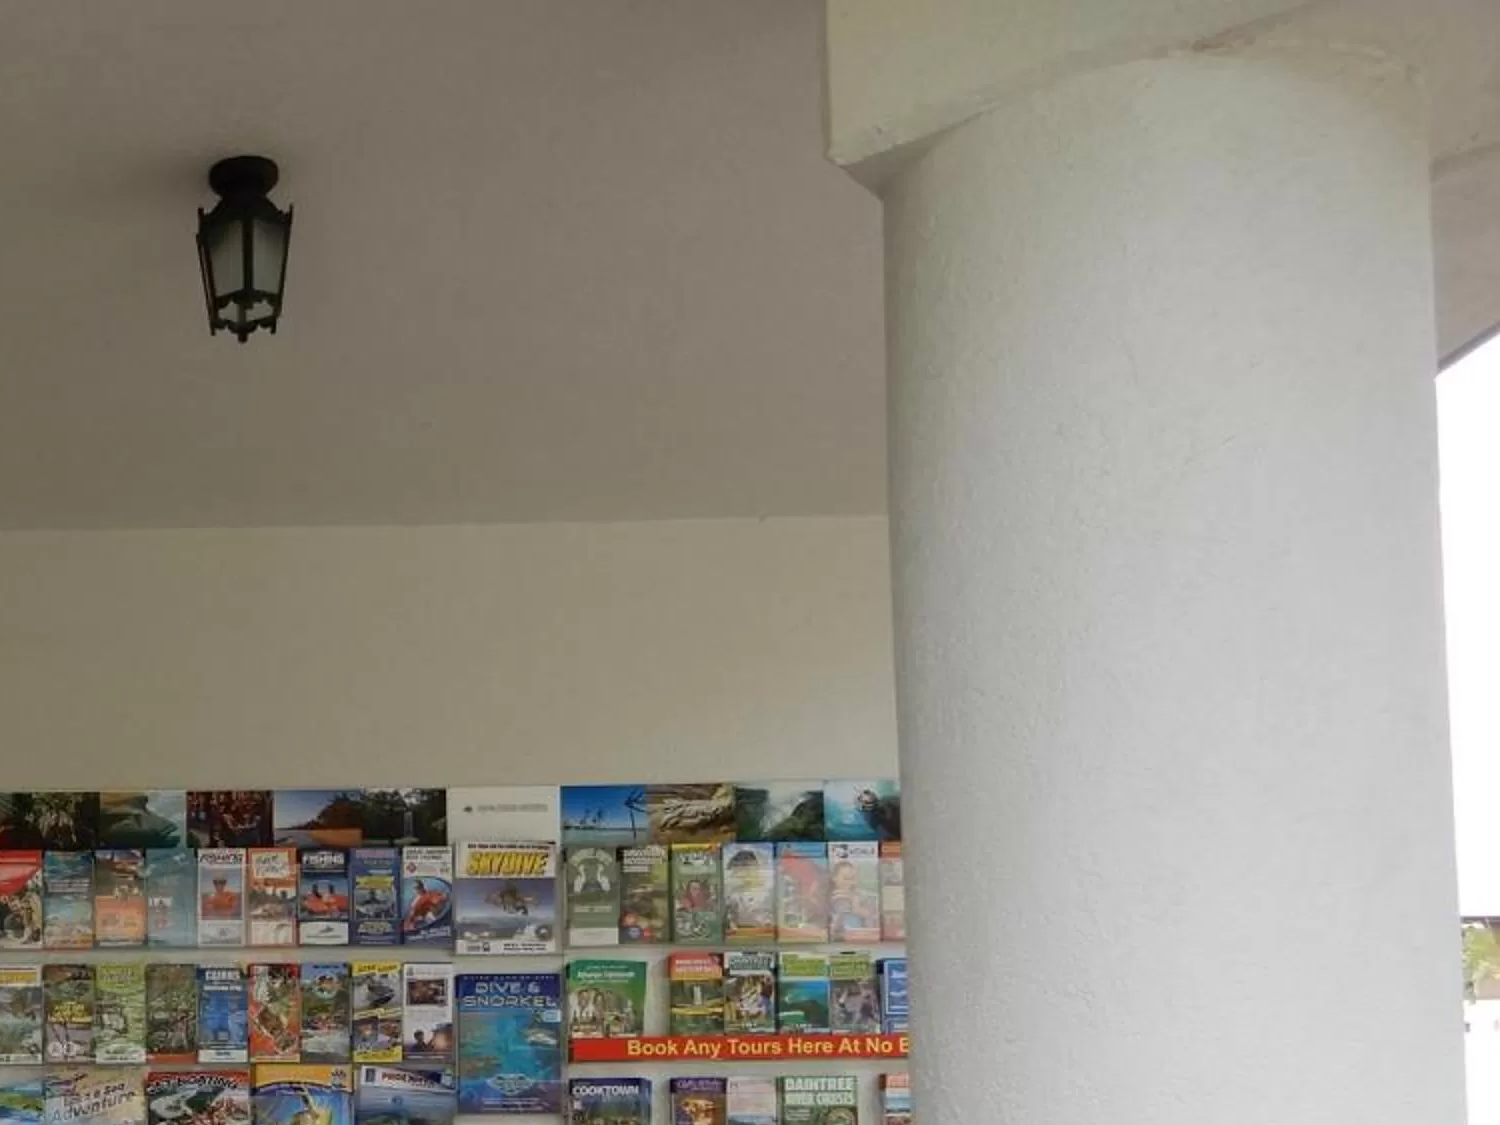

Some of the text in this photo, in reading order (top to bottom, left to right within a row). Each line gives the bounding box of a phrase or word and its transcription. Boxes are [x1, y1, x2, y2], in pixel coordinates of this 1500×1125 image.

[467, 851, 549, 877] SKYDIVE
[475, 981, 541, 994] DIVE &
[464, 996, 556, 1008] SNORKEL
[627, 1039, 678, 1056] Book
[683, 1040, 722, 1059] Any
[726, 1038, 782, 1055] Tours
[788, 1038, 833, 1054] Here
[838, 1037, 860, 1054] At
[866, 1036, 893, 1053] No
[785, 1077, 854, 1091] DAINTREE
[571, 1085, 639, 1097] COOKTOWN
